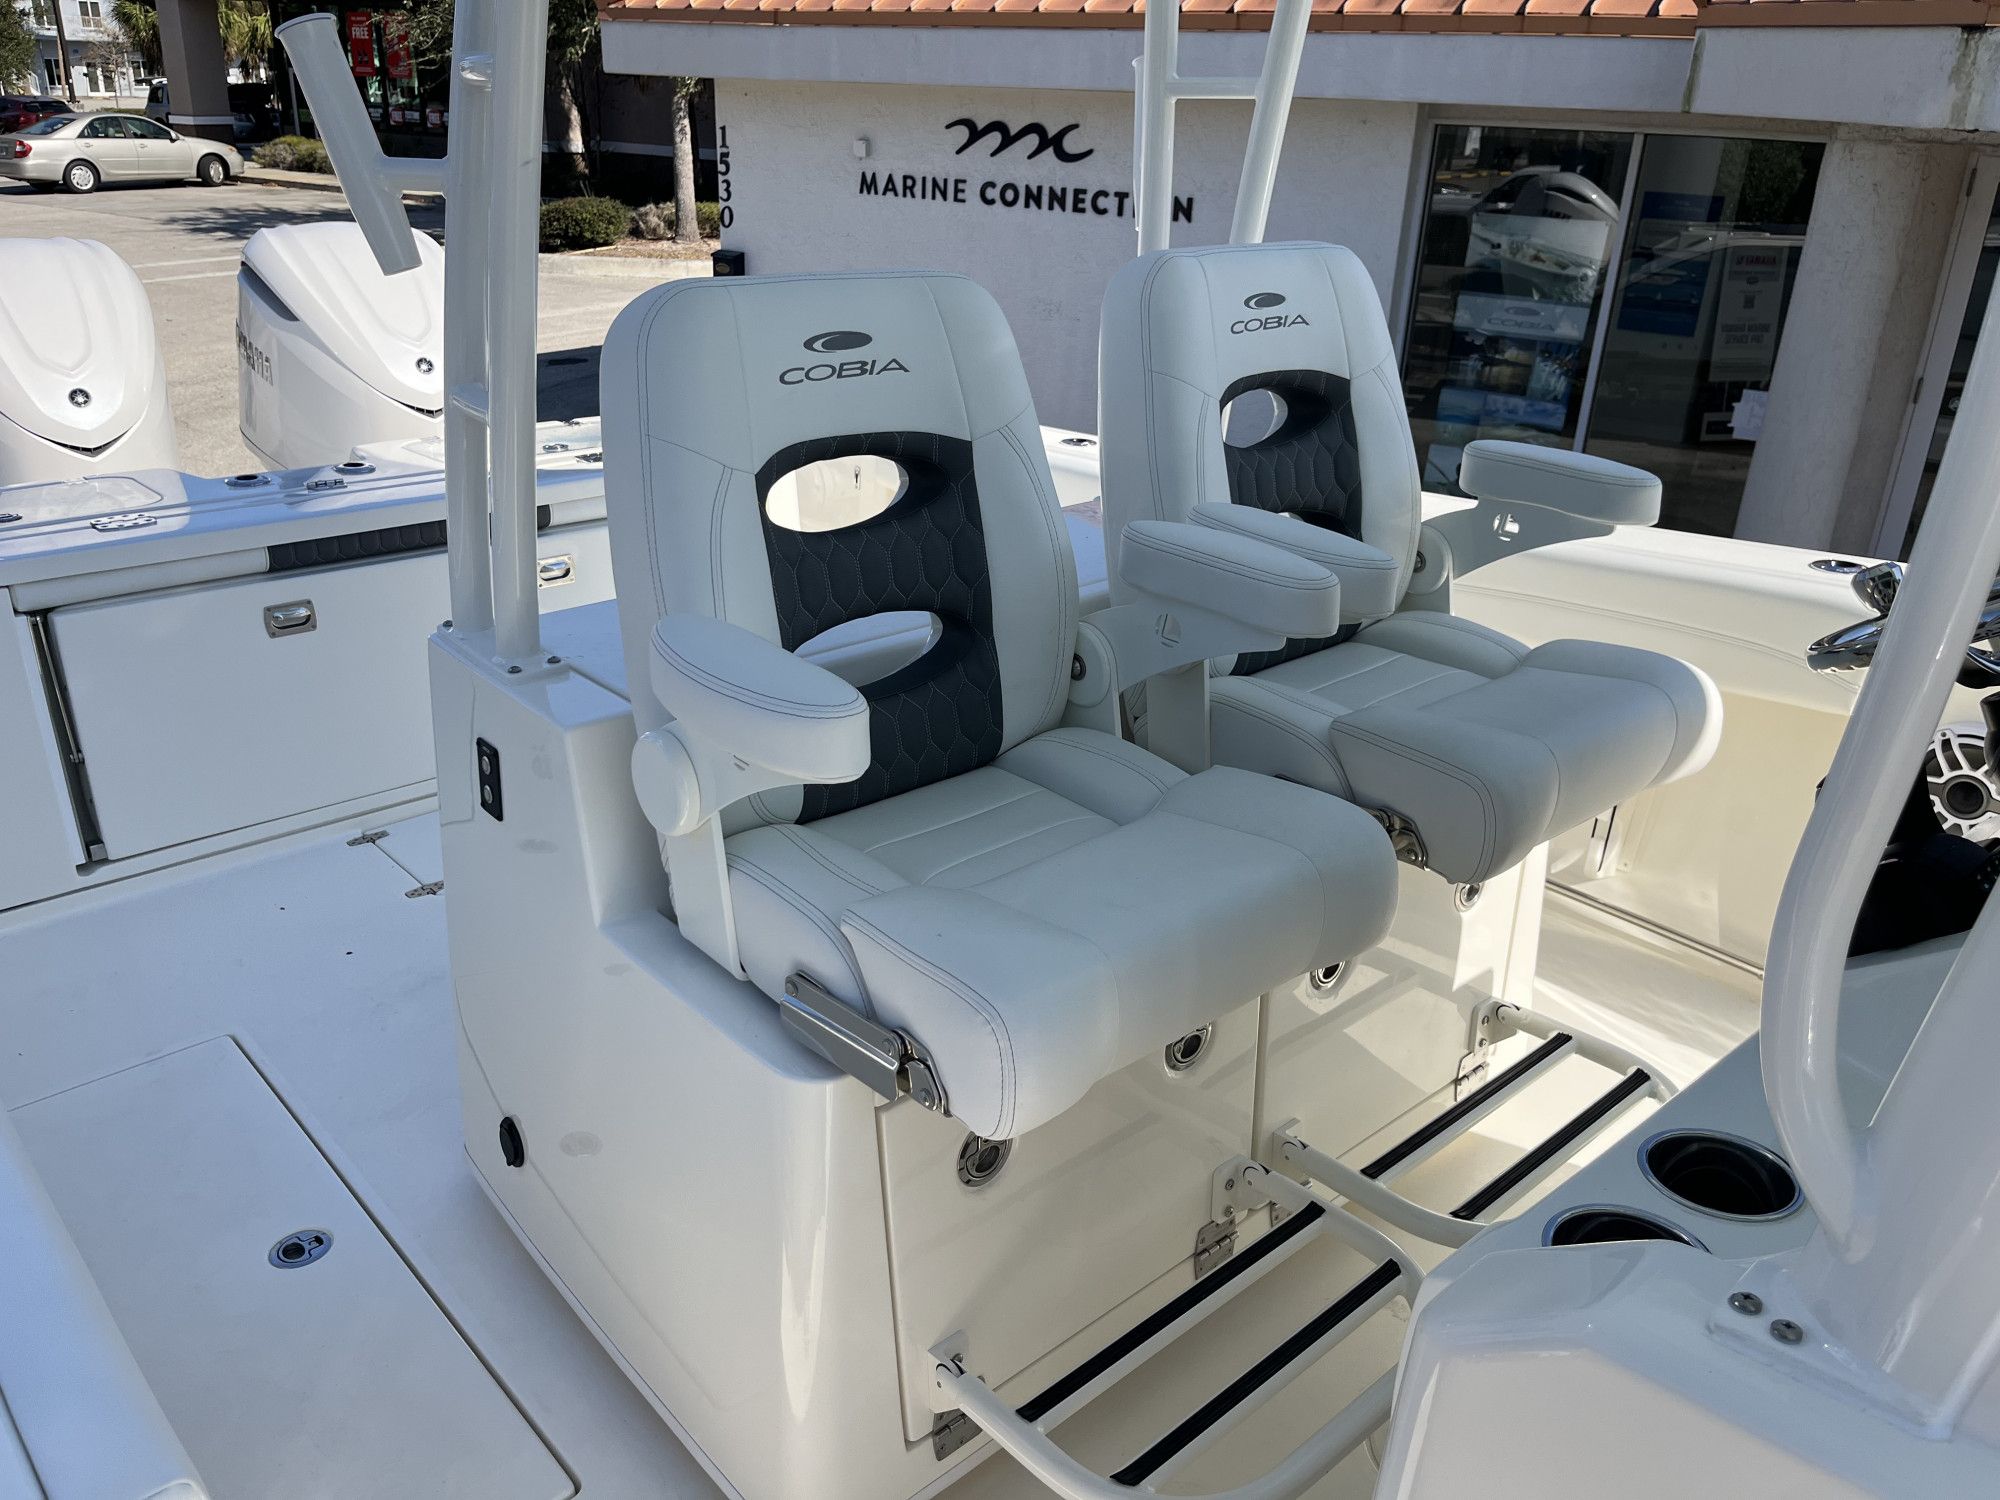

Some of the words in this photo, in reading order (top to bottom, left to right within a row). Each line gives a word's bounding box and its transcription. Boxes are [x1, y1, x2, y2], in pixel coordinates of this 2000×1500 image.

[718, 125, 734, 229] 1530
[859, 171, 967, 203] MARINE
[979, 181, 1194, 223] CONNECTN
[1230, 314, 1310, 335] COBIA
[779, 358, 911, 385] COBIA
